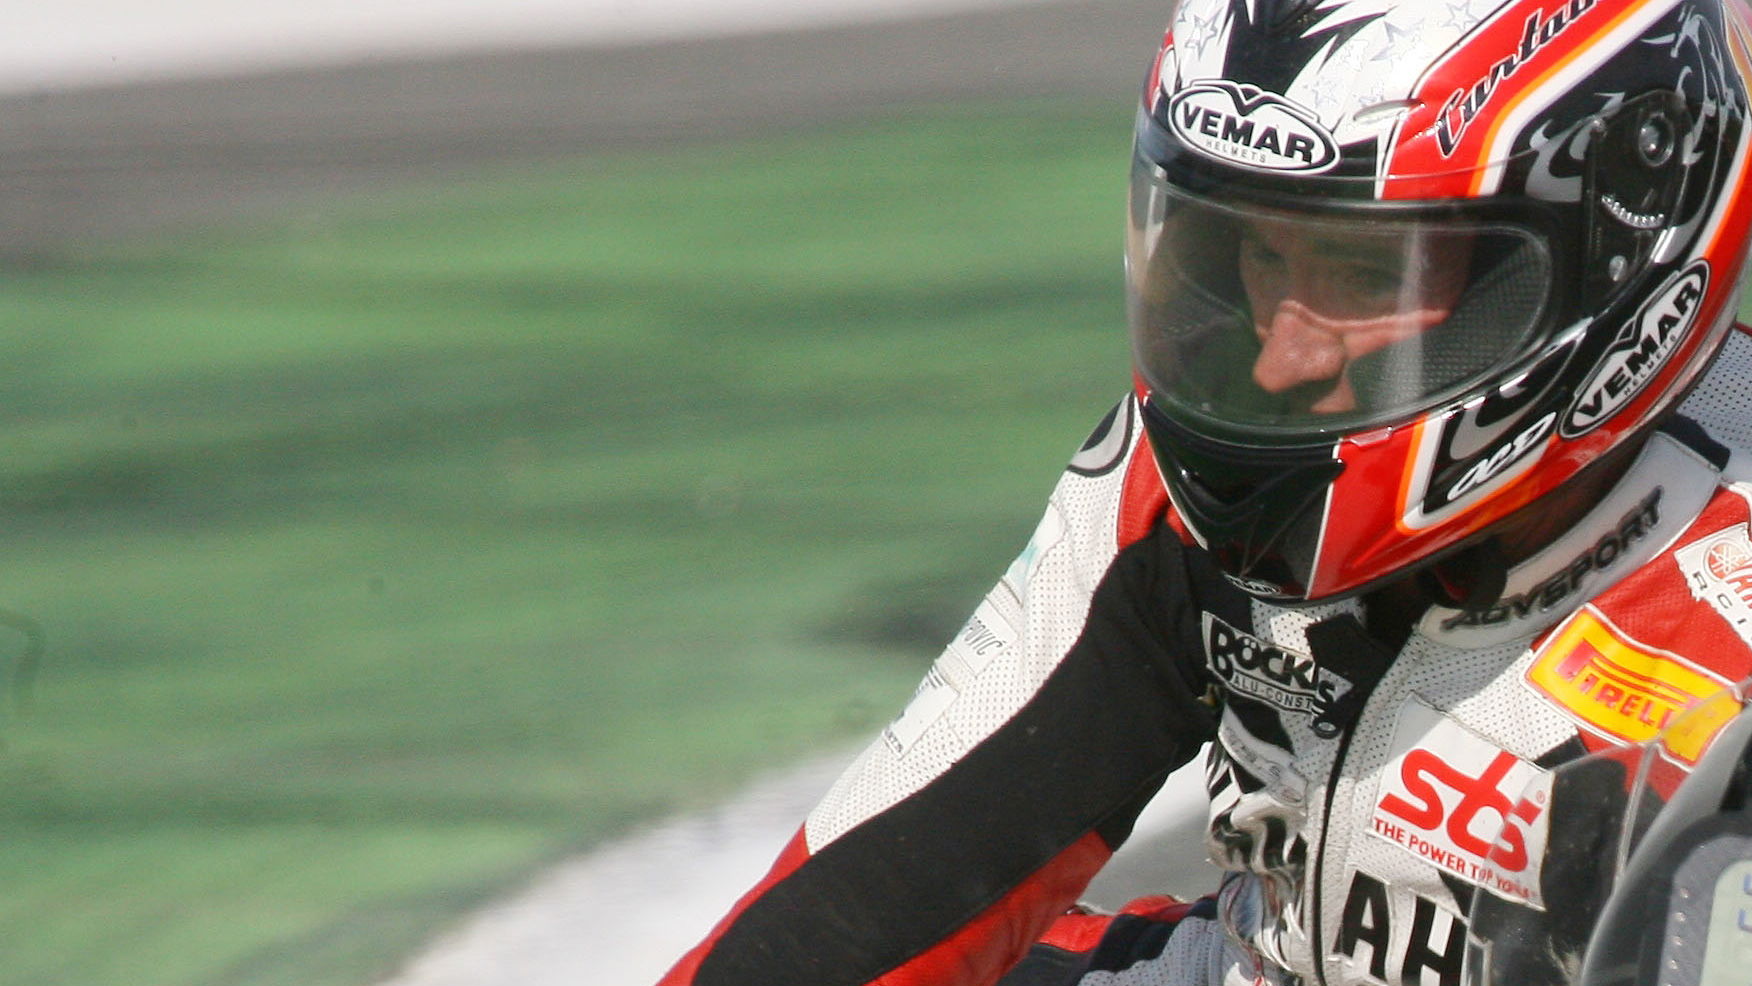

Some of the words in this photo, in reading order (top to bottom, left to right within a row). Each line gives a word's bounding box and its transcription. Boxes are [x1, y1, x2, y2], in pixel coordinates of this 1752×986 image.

[1182, 101, 1315, 164] VEMAR
[1205, 138, 1267, 163] HELMETS
[1576, 280, 1701, 418] VEMAR
[1373, 818, 1406, 844] THE
[1408, 833, 1467, 875] POWER
[1470, 862, 1494, 886] TOP
